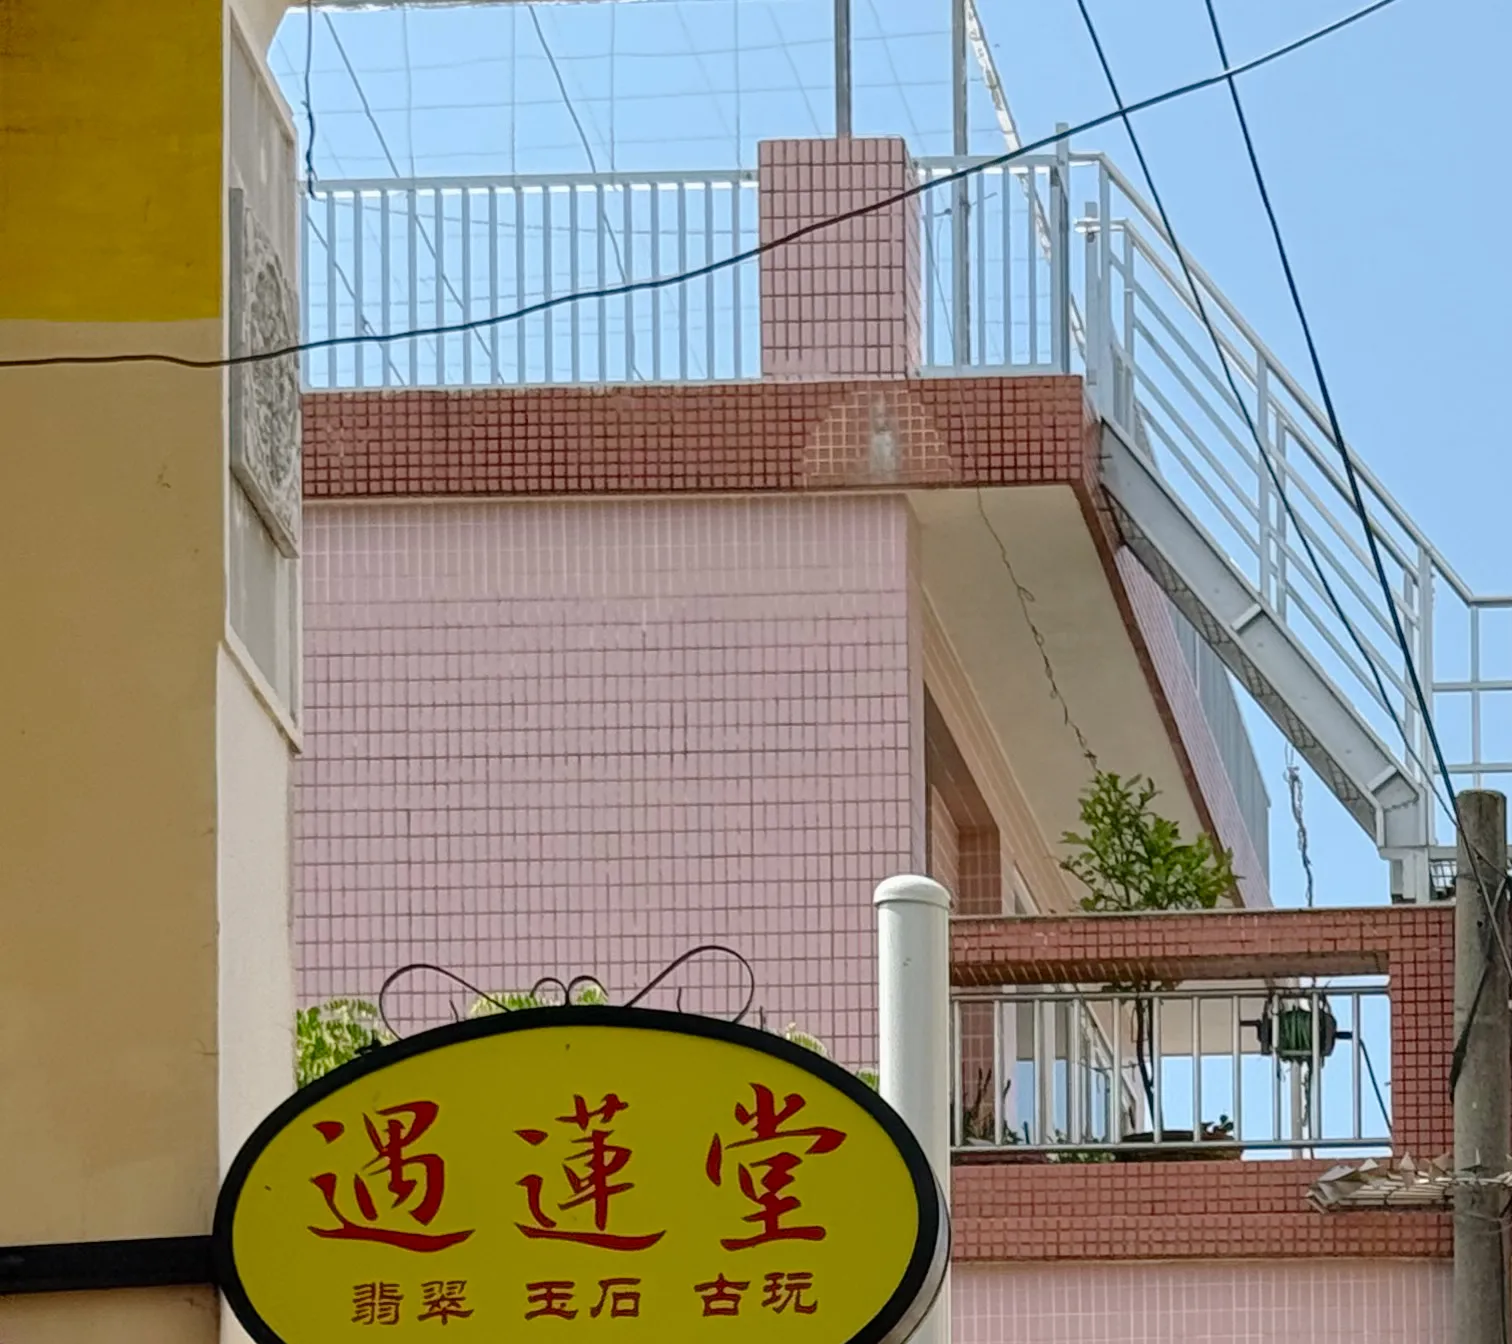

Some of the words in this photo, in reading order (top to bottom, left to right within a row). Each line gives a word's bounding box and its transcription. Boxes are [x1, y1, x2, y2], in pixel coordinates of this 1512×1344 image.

[307, 1081, 848, 1253] 遇蓮堂
[351, 1279, 475, 1326] 翡翠
[524, 1277, 642, 1320] 玉石
[694, 1271, 819, 1318] 古玩
